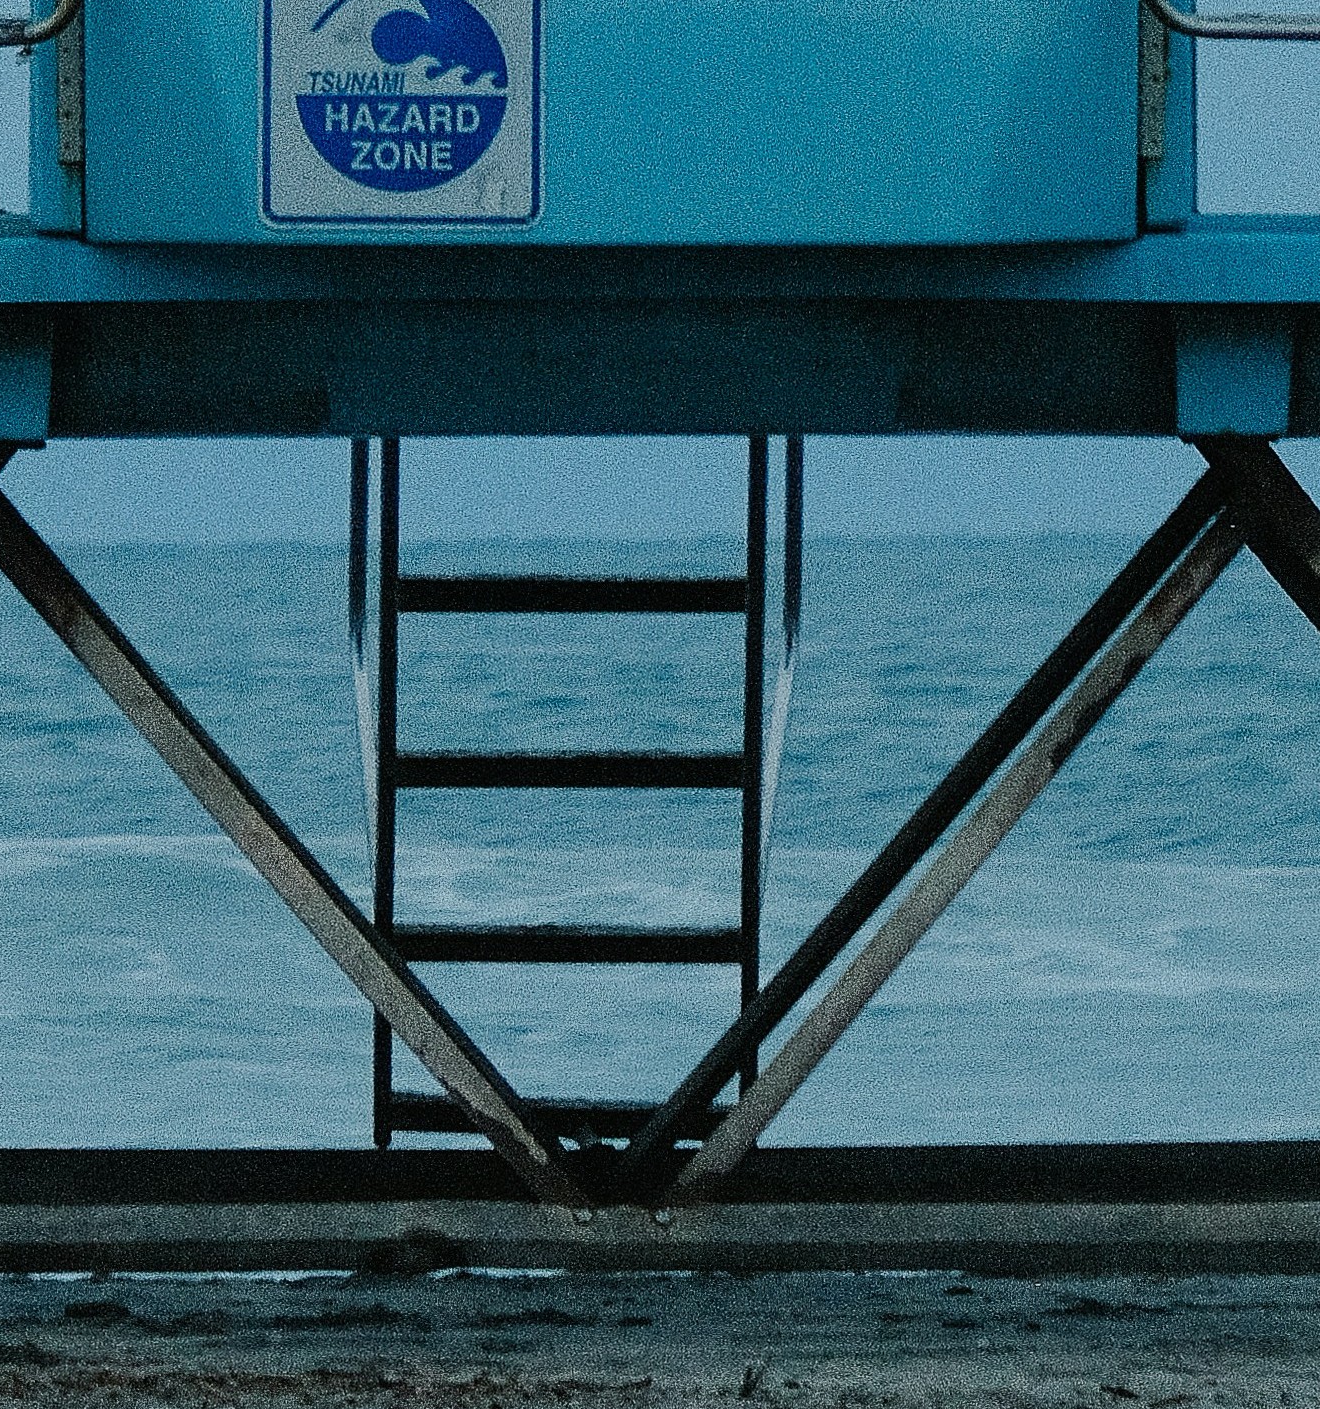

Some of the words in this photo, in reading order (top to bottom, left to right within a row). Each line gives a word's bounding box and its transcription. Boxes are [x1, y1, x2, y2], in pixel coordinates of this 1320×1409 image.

[308, 71, 406, 93] TSUNAMI
[324, 103, 480, 134] HAZARD
[351, 141, 453, 171] ZONE
